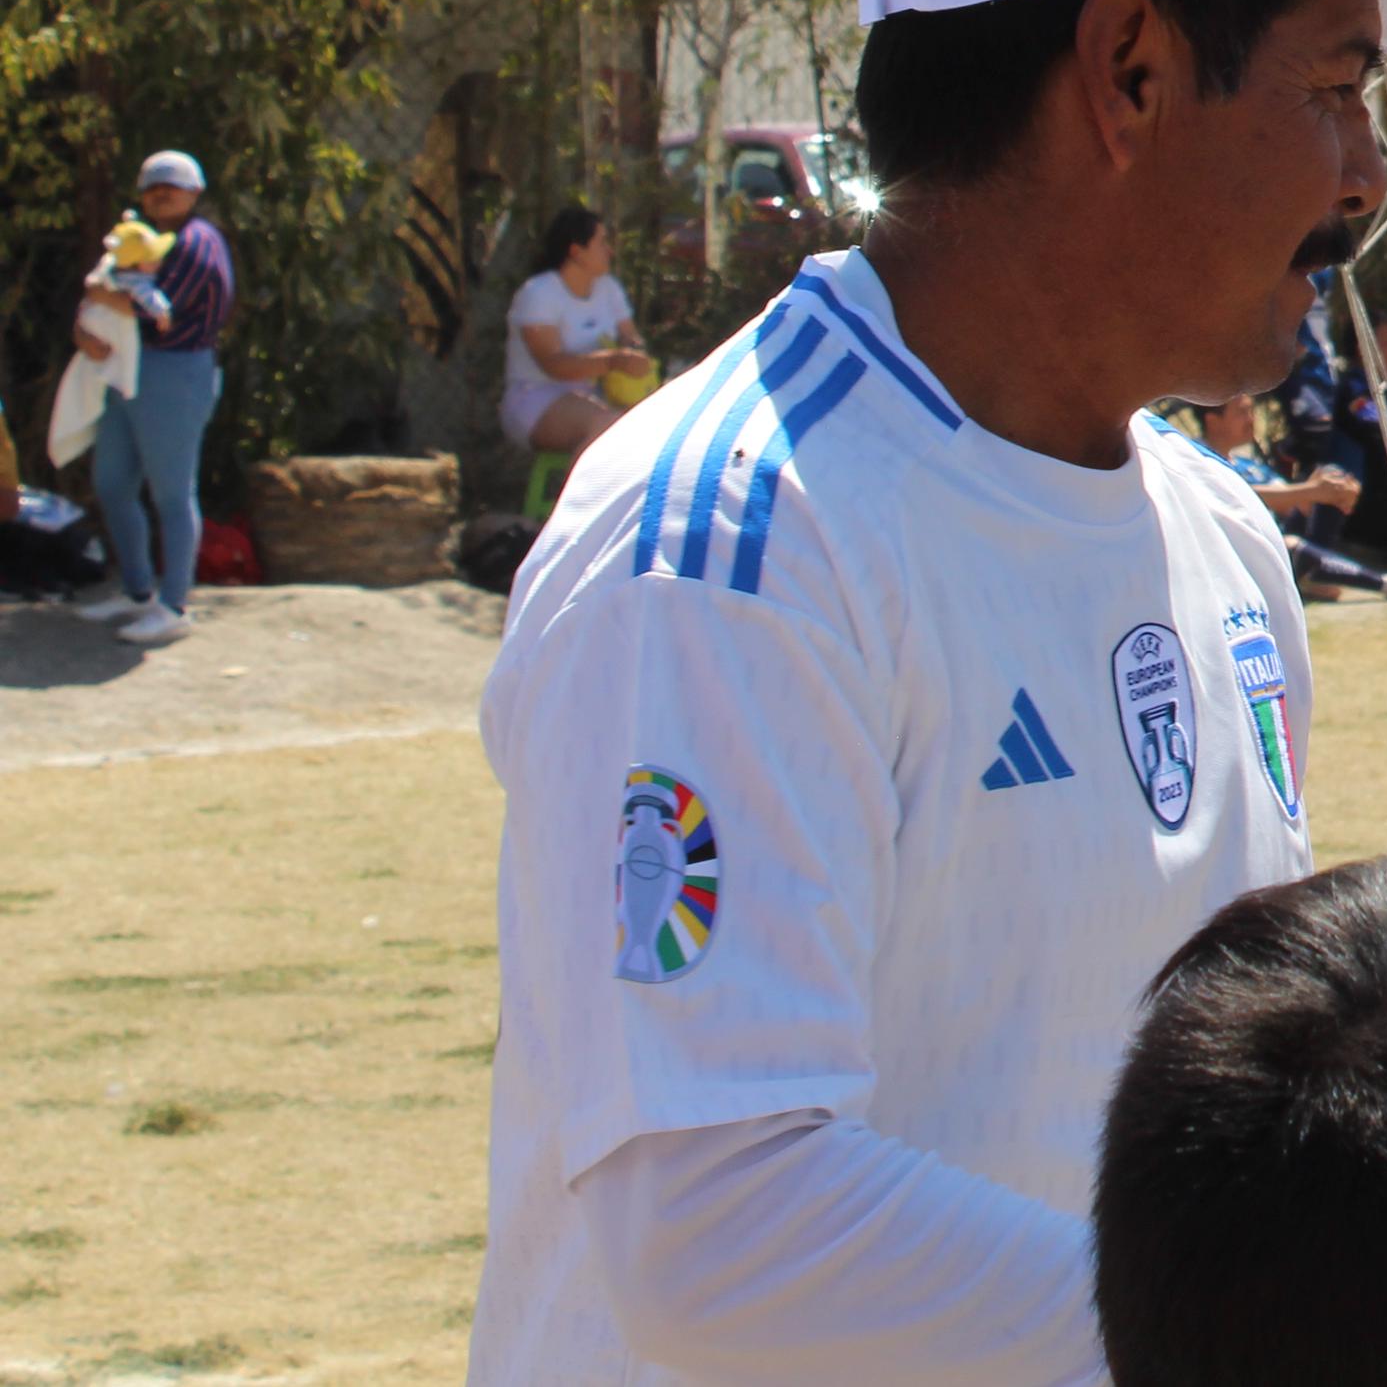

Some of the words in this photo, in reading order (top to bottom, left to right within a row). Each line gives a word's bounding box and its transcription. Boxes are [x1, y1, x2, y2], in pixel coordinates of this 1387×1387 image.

[1127, 658, 1175, 686] EUROPEAN
[1130, 676, 1178, 701] CHAMPIONS
[1159, 781, 1184, 803] 2023
